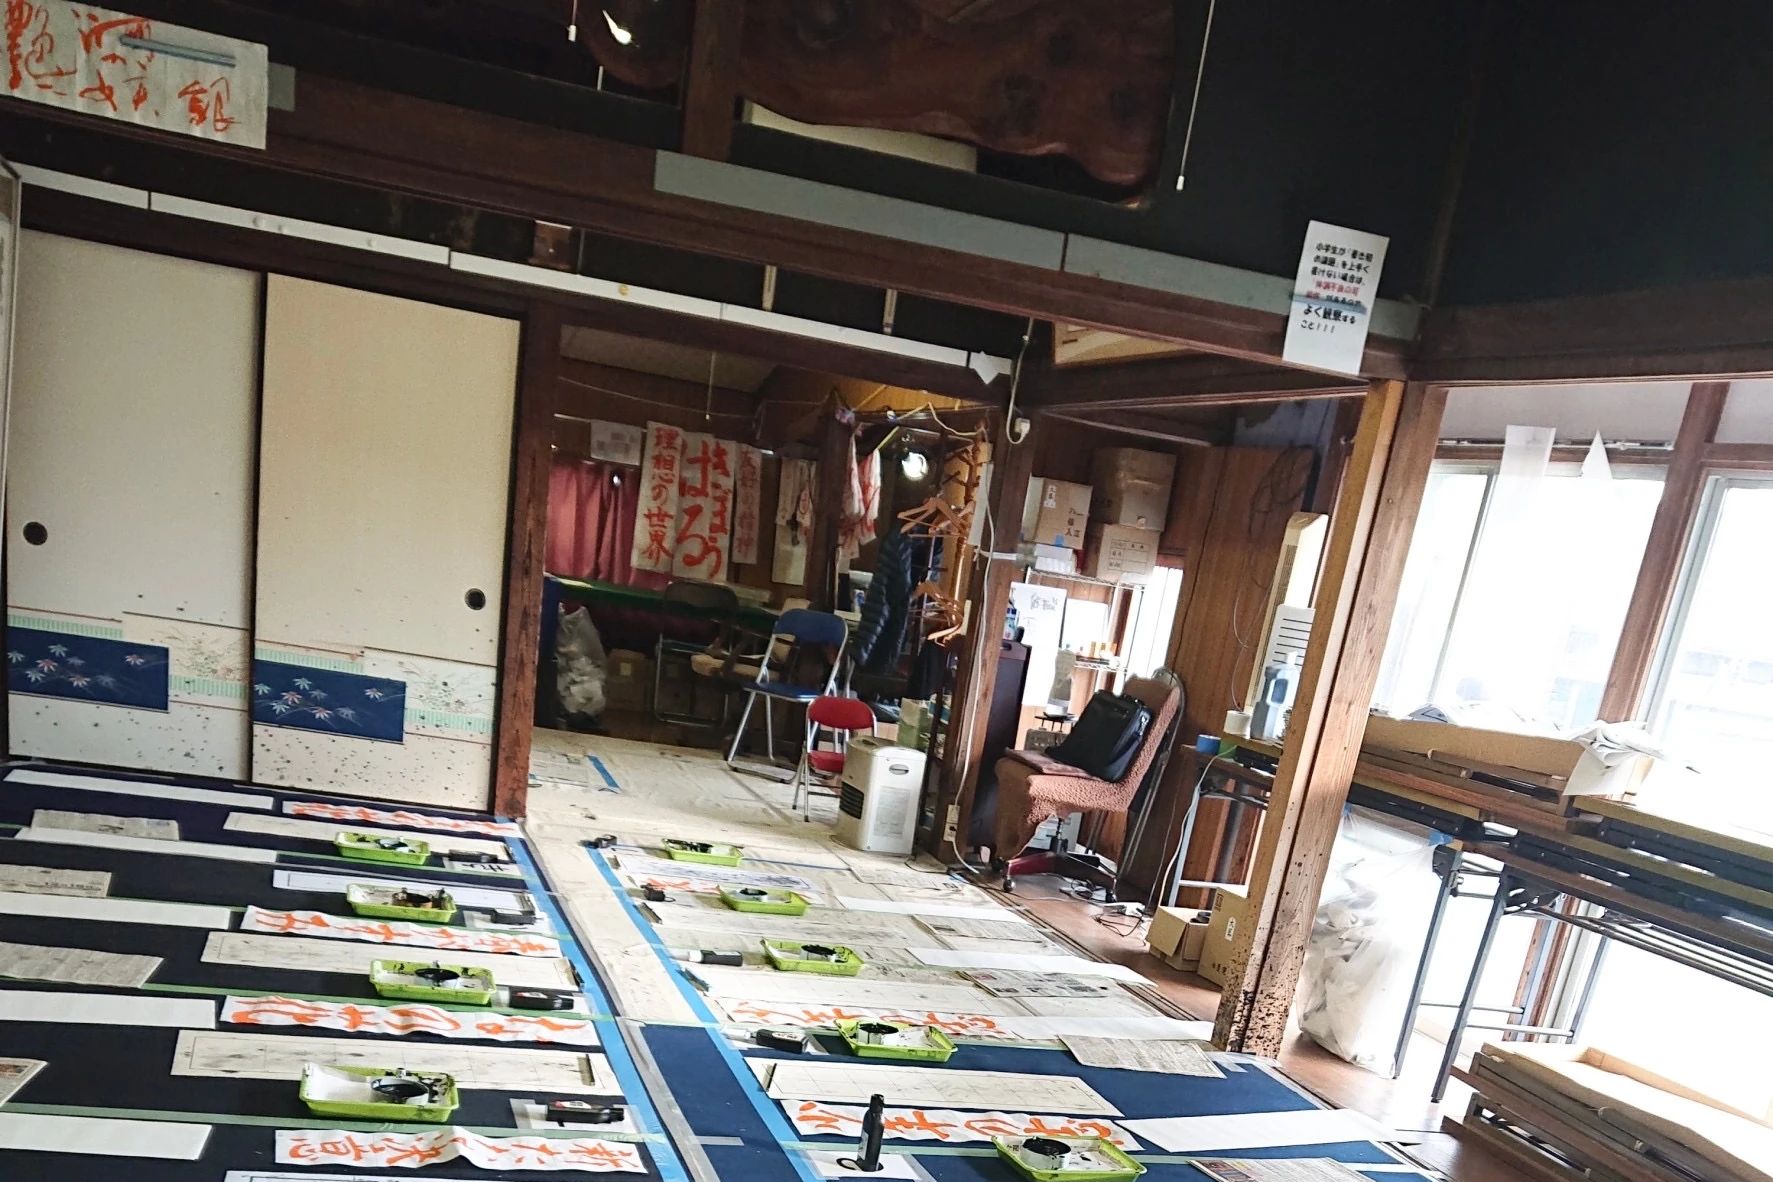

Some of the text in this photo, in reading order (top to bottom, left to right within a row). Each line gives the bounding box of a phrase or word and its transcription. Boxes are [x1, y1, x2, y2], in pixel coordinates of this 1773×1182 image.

[1303, 304, 1356, 324] よく観察する
[641, 426, 679, 567] 理想の世界
[254, 908, 557, 953] 春がすみ
[230, 995, 588, 1043] なの花
[287, 1134, 634, 1169] 新たな決意
